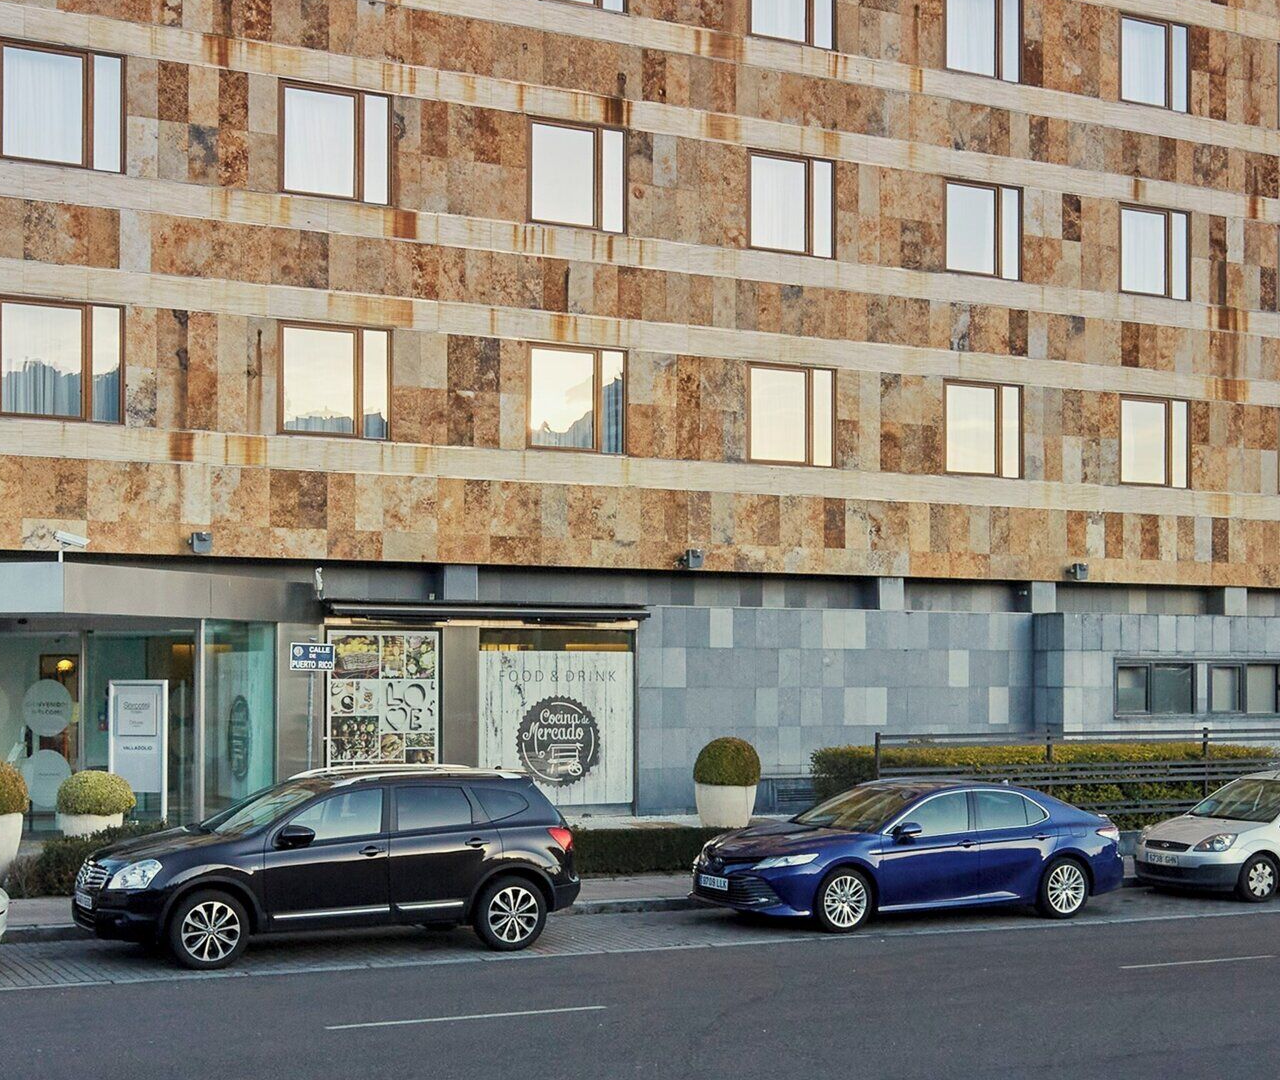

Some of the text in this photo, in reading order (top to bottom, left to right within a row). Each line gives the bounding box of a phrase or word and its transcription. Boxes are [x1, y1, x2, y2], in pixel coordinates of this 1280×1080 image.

[309, 646, 331, 654] CALLE
[292, 660, 333, 669] PUERTO RICO
[499, 670, 616, 682] FOOD & DRINK
[540, 708, 580, 725] Cocina
[522, 721, 584, 748] Mercado
